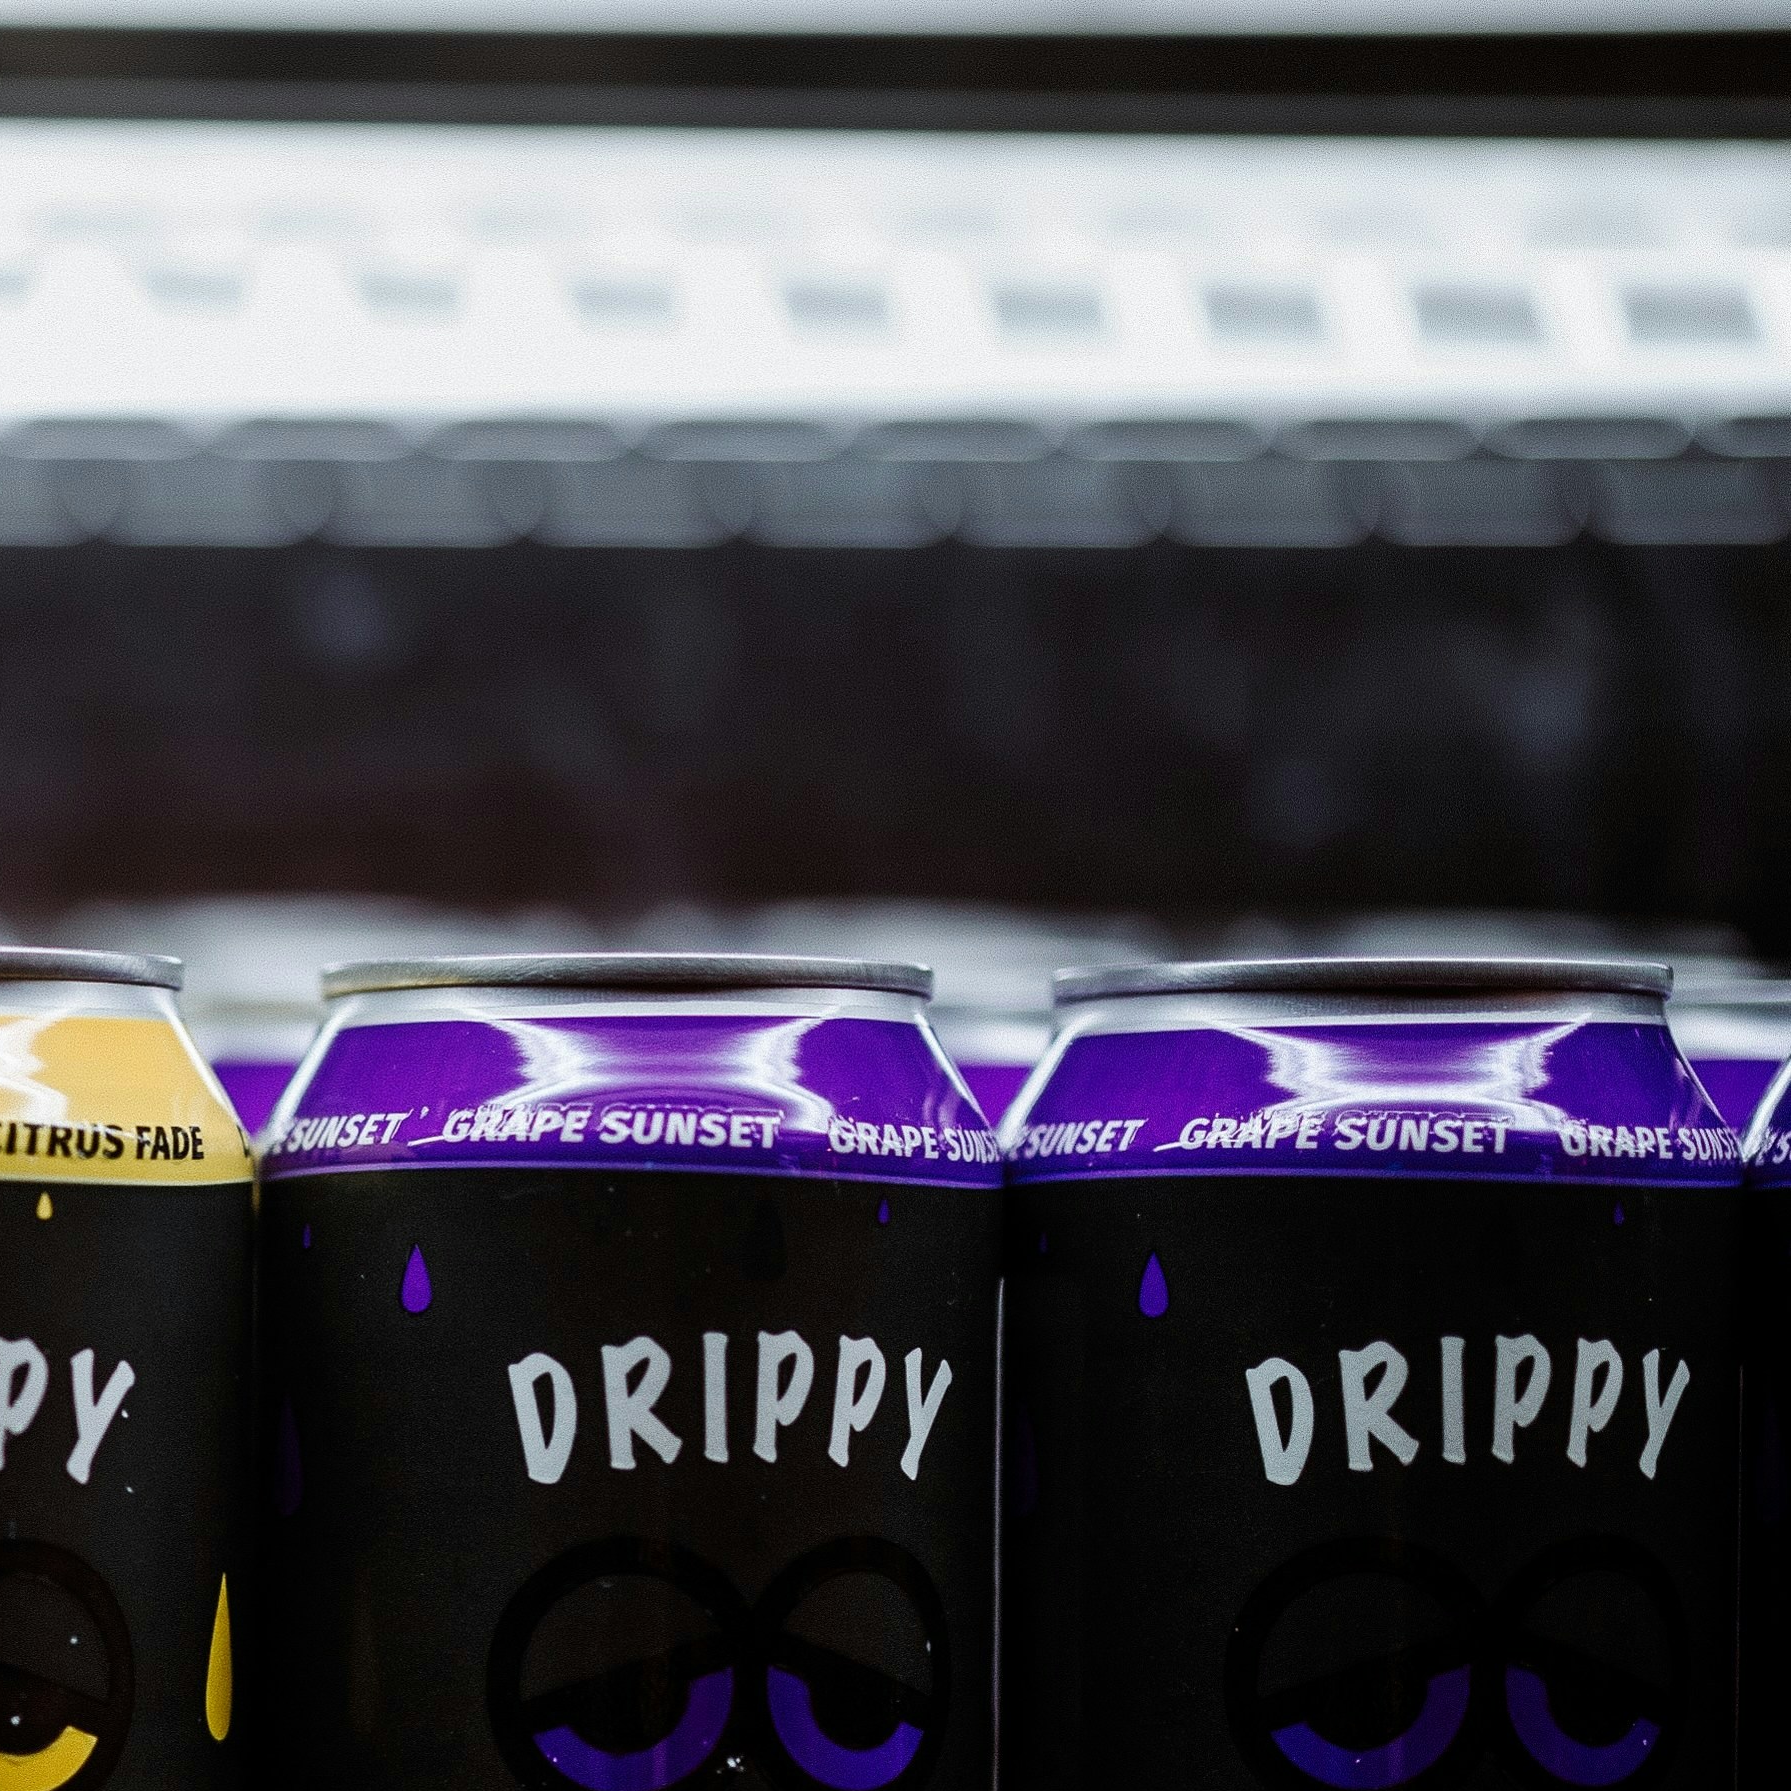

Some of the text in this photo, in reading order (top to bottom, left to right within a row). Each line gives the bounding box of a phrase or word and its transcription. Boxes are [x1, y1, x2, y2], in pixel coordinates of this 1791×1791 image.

[134, 1123, 205, 1161] FADE
[441, 1104, 781, 1149] GRAPE SUNSET
[1175, 1112, 1512, 1154] GRAPE SUNSET
[507, 1329, 954, 1485] DRIPPY
[1245, 1333, 1691, 1487] DRIPPY
